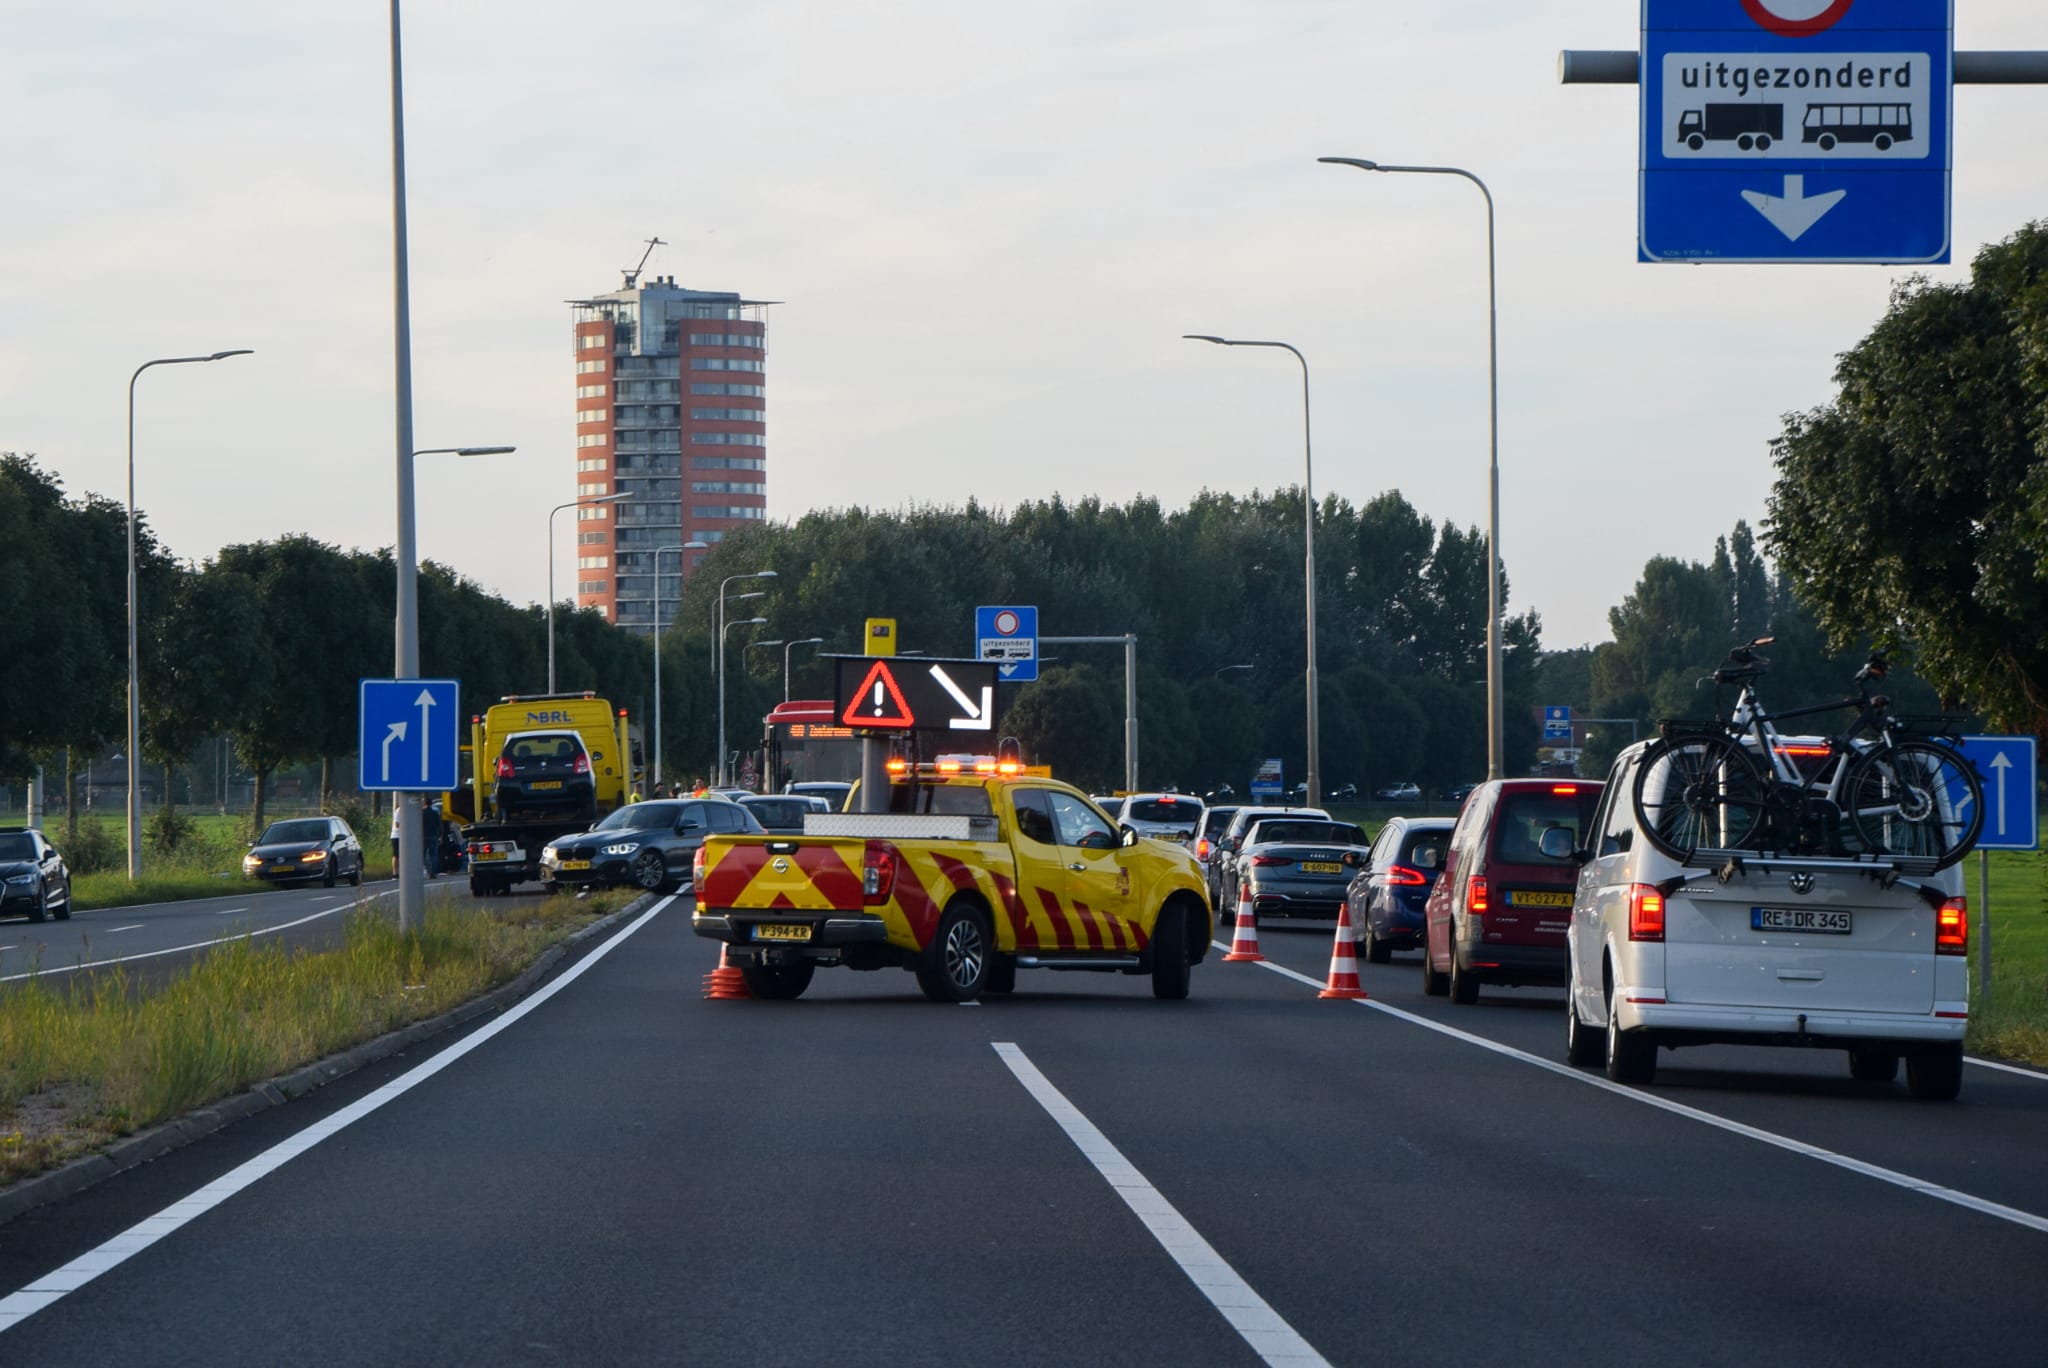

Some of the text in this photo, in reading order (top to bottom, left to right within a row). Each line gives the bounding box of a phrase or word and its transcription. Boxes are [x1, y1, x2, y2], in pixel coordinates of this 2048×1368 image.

[1682, 61, 1912, 97] uitgezonderd
[1516, 893, 1569, 905] VT-027-X
[1762, 910, 1849, 929] RE DR 345
[760, 925, 808, 938] V-394-KR
